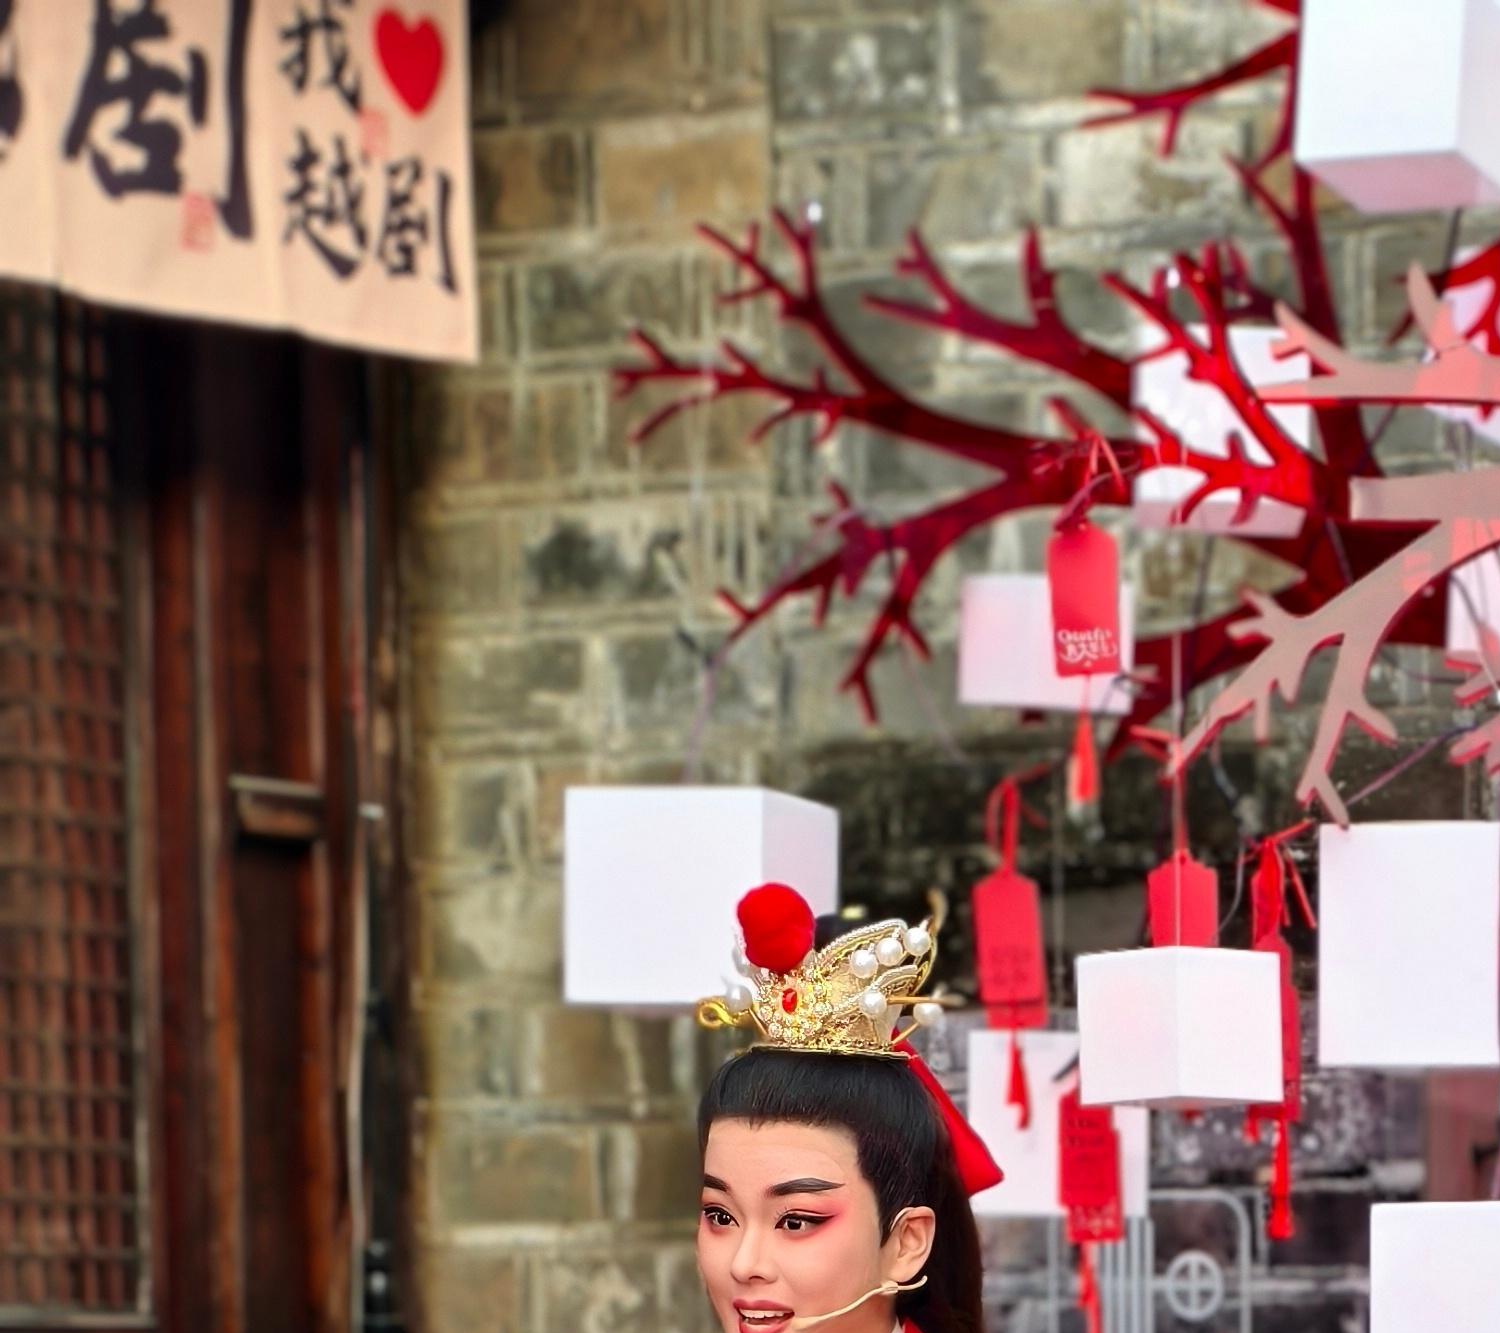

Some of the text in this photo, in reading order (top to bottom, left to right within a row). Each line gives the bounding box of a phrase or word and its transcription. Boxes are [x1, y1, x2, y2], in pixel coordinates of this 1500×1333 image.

[0, 0, 254, 243] 剧
[277, 0, 362, 114] 我
[282, 132, 458, 296] 越剧
